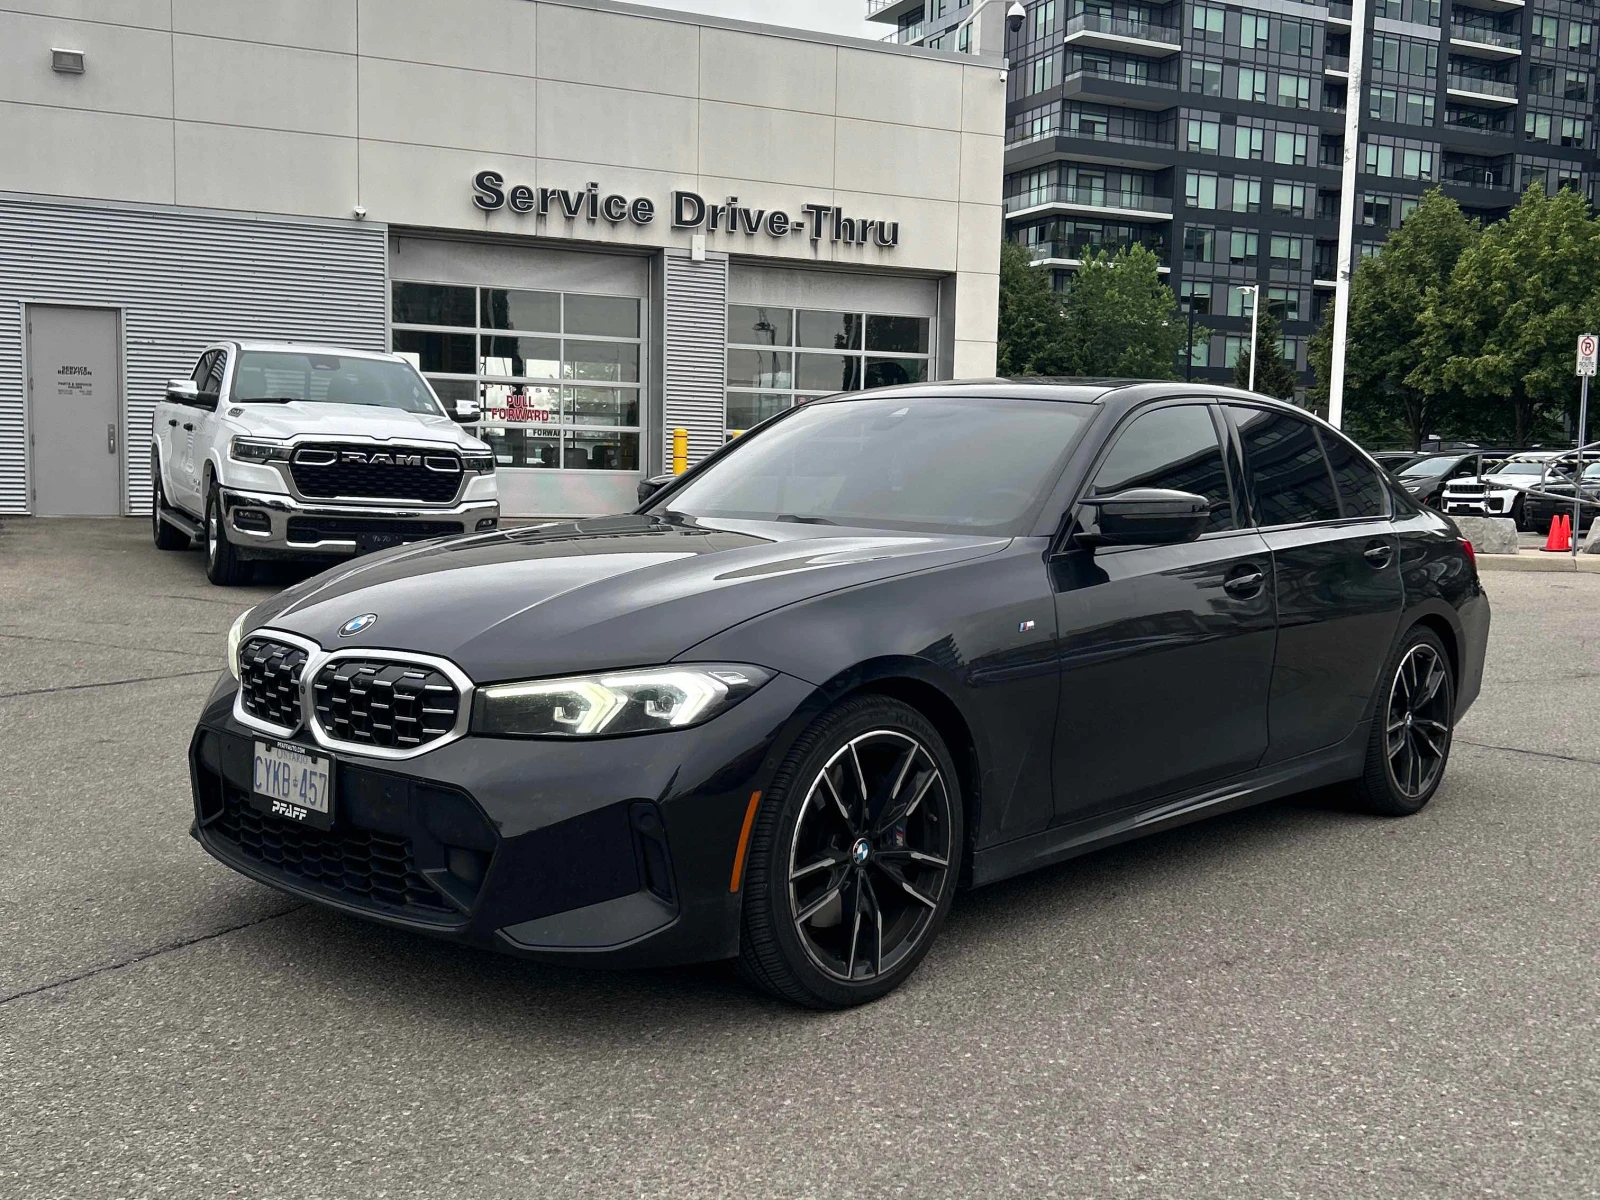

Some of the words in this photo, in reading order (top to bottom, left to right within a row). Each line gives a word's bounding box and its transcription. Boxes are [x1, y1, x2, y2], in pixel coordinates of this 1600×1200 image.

[472, 170, 654, 225] Service
[671, 190, 900, 247] Drive-Thru
[506, 395, 535, 408] PULL
[491, 407, 549, 421] FORWARD
[341, 451, 421, 466] RAM
[276, 749, 308, 765] ONTARIO
[254, 755, 291, 798] CYKB
[299, 768, 328, 808] 457
[271, 799, 308, 820] PFAFF
